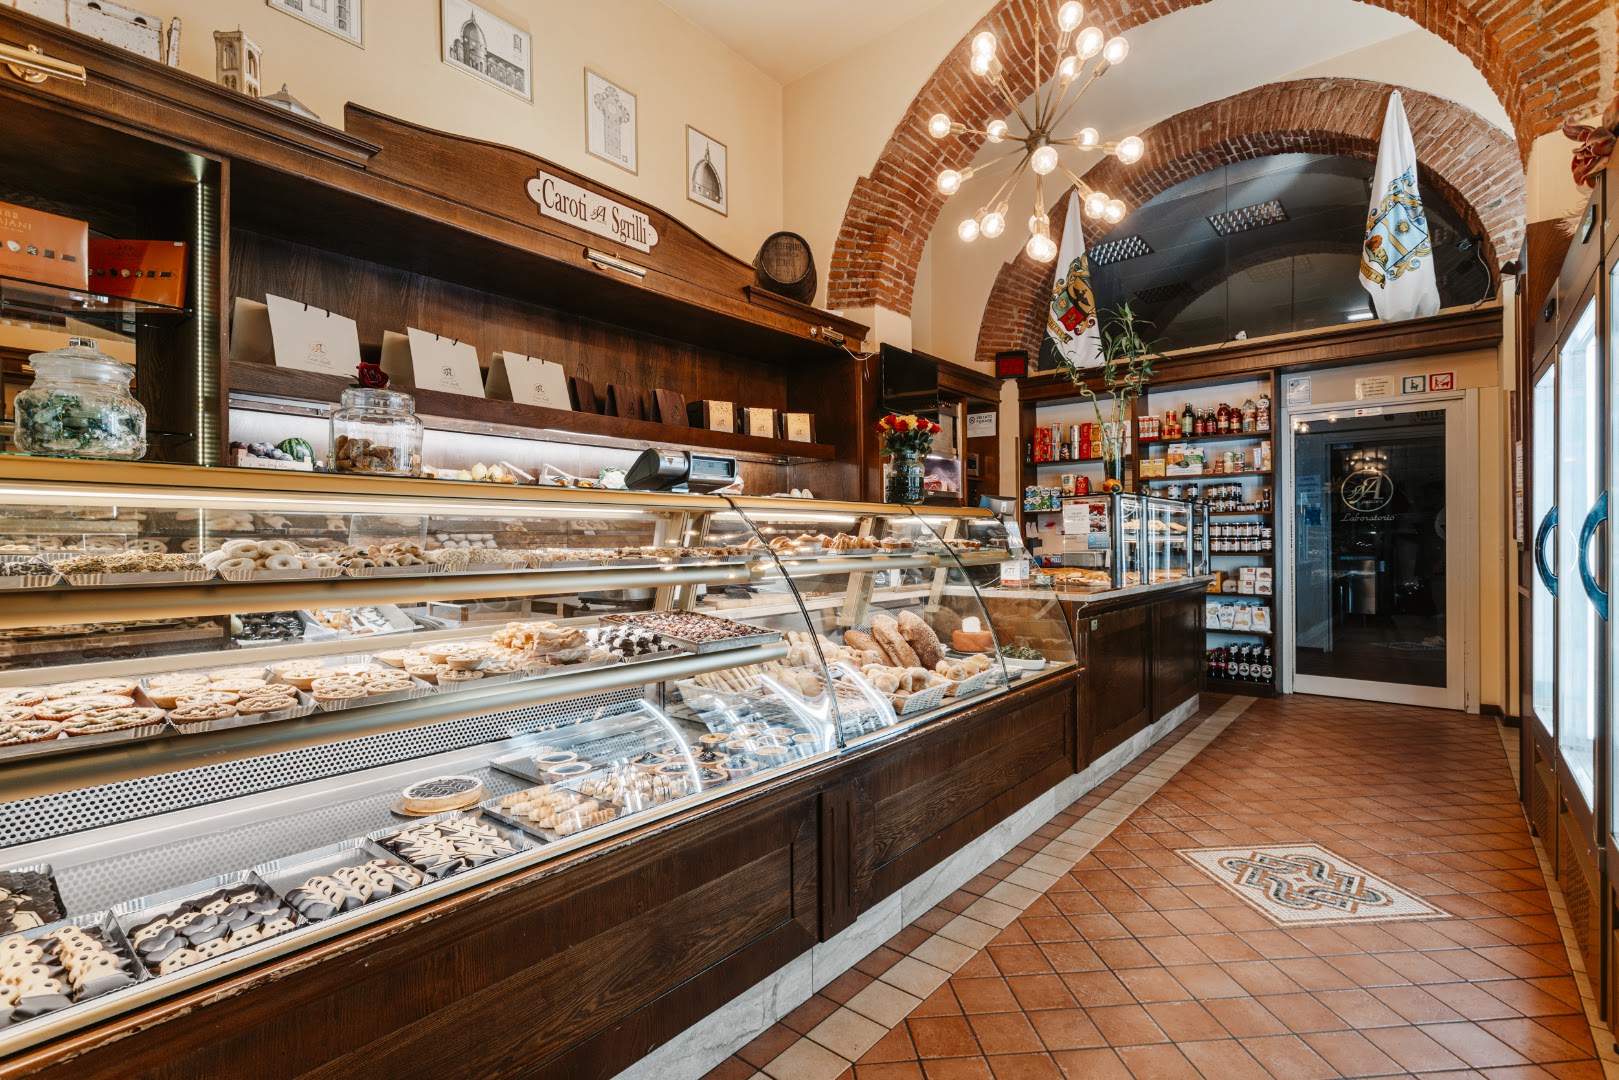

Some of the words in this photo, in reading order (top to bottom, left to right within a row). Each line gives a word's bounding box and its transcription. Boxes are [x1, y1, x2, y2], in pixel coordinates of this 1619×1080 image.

[542, 178, 588, 222] Caroti
[611, 206, 648, 245] Sgrilli
[1339, 512, 1395, 522] Laboratorio
